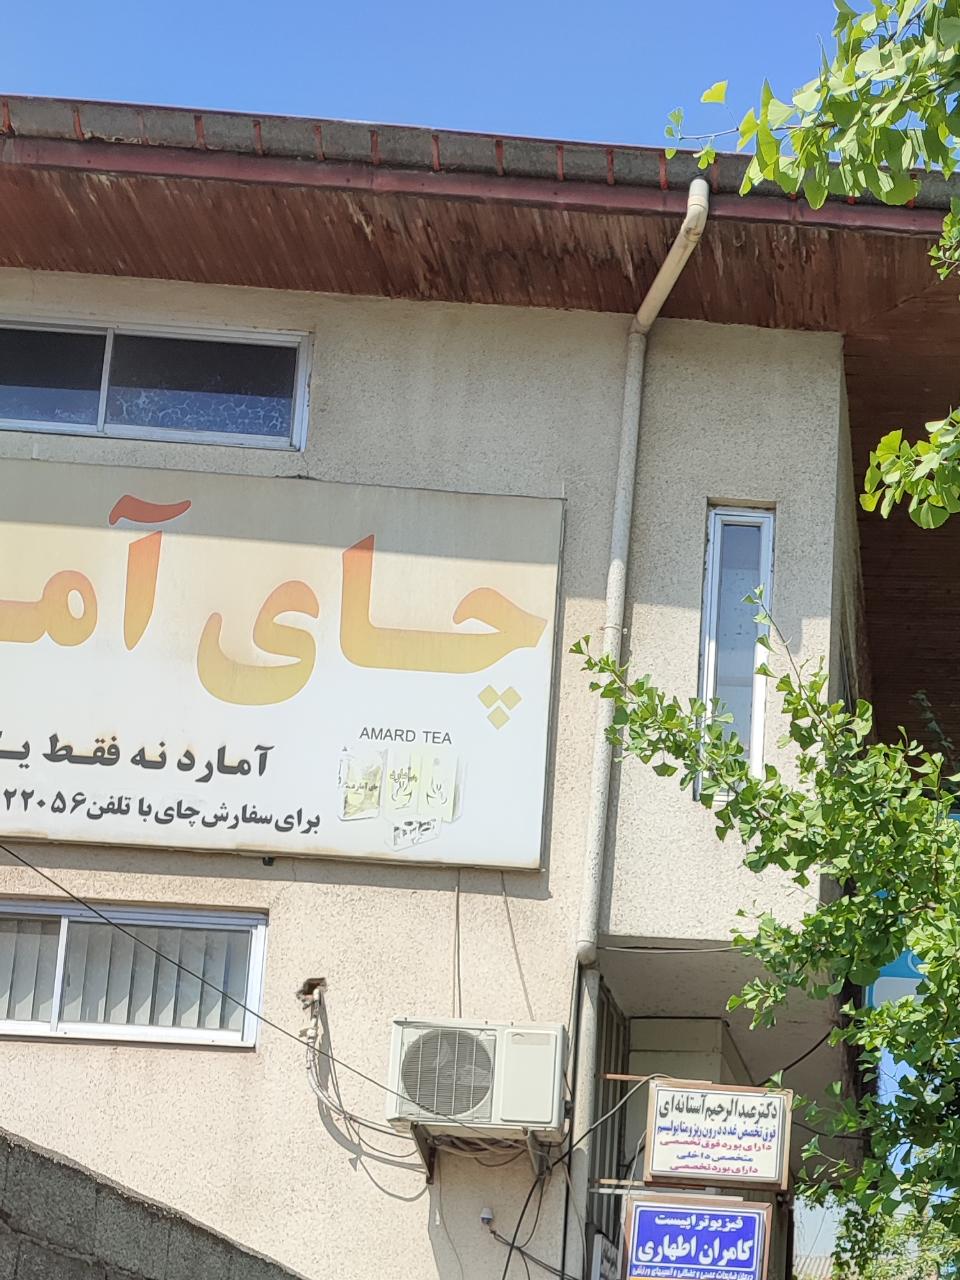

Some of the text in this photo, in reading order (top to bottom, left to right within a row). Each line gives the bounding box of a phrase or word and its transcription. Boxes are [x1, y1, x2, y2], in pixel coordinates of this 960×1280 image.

[197, 534, 548, 730] چای
[359, 727, 452, 744] AMARD TEA
[42, 733, 121, 767] فقط
[130, 740, 168, 770] نه
[176, 744, 275, 783] آمارد
[86, 795, 131, 820] تلفن
[138, 797, 152, 823] با
[154, 799, 200, 827] چای
[201, 803, 273, 829] سفارش
[274, 807, 321, 834] برای
[755, 1100, 778, 1124] دکتر
[737, 1122, 762, 1139] تخصص
[762, 1124, 776, 1142] فوق
[660, 1137, 772, 1151] دارای بورد فوق تخصصی
[676, 1151, 753, 1162] متخصص داخلی
[670, 1162, 758, 1174] دارای بورد تخصصی
[655, 1214, 743, 1232] فیزیوتراپیست
[638, 1234, 753, 1266] کامران اطهاری
